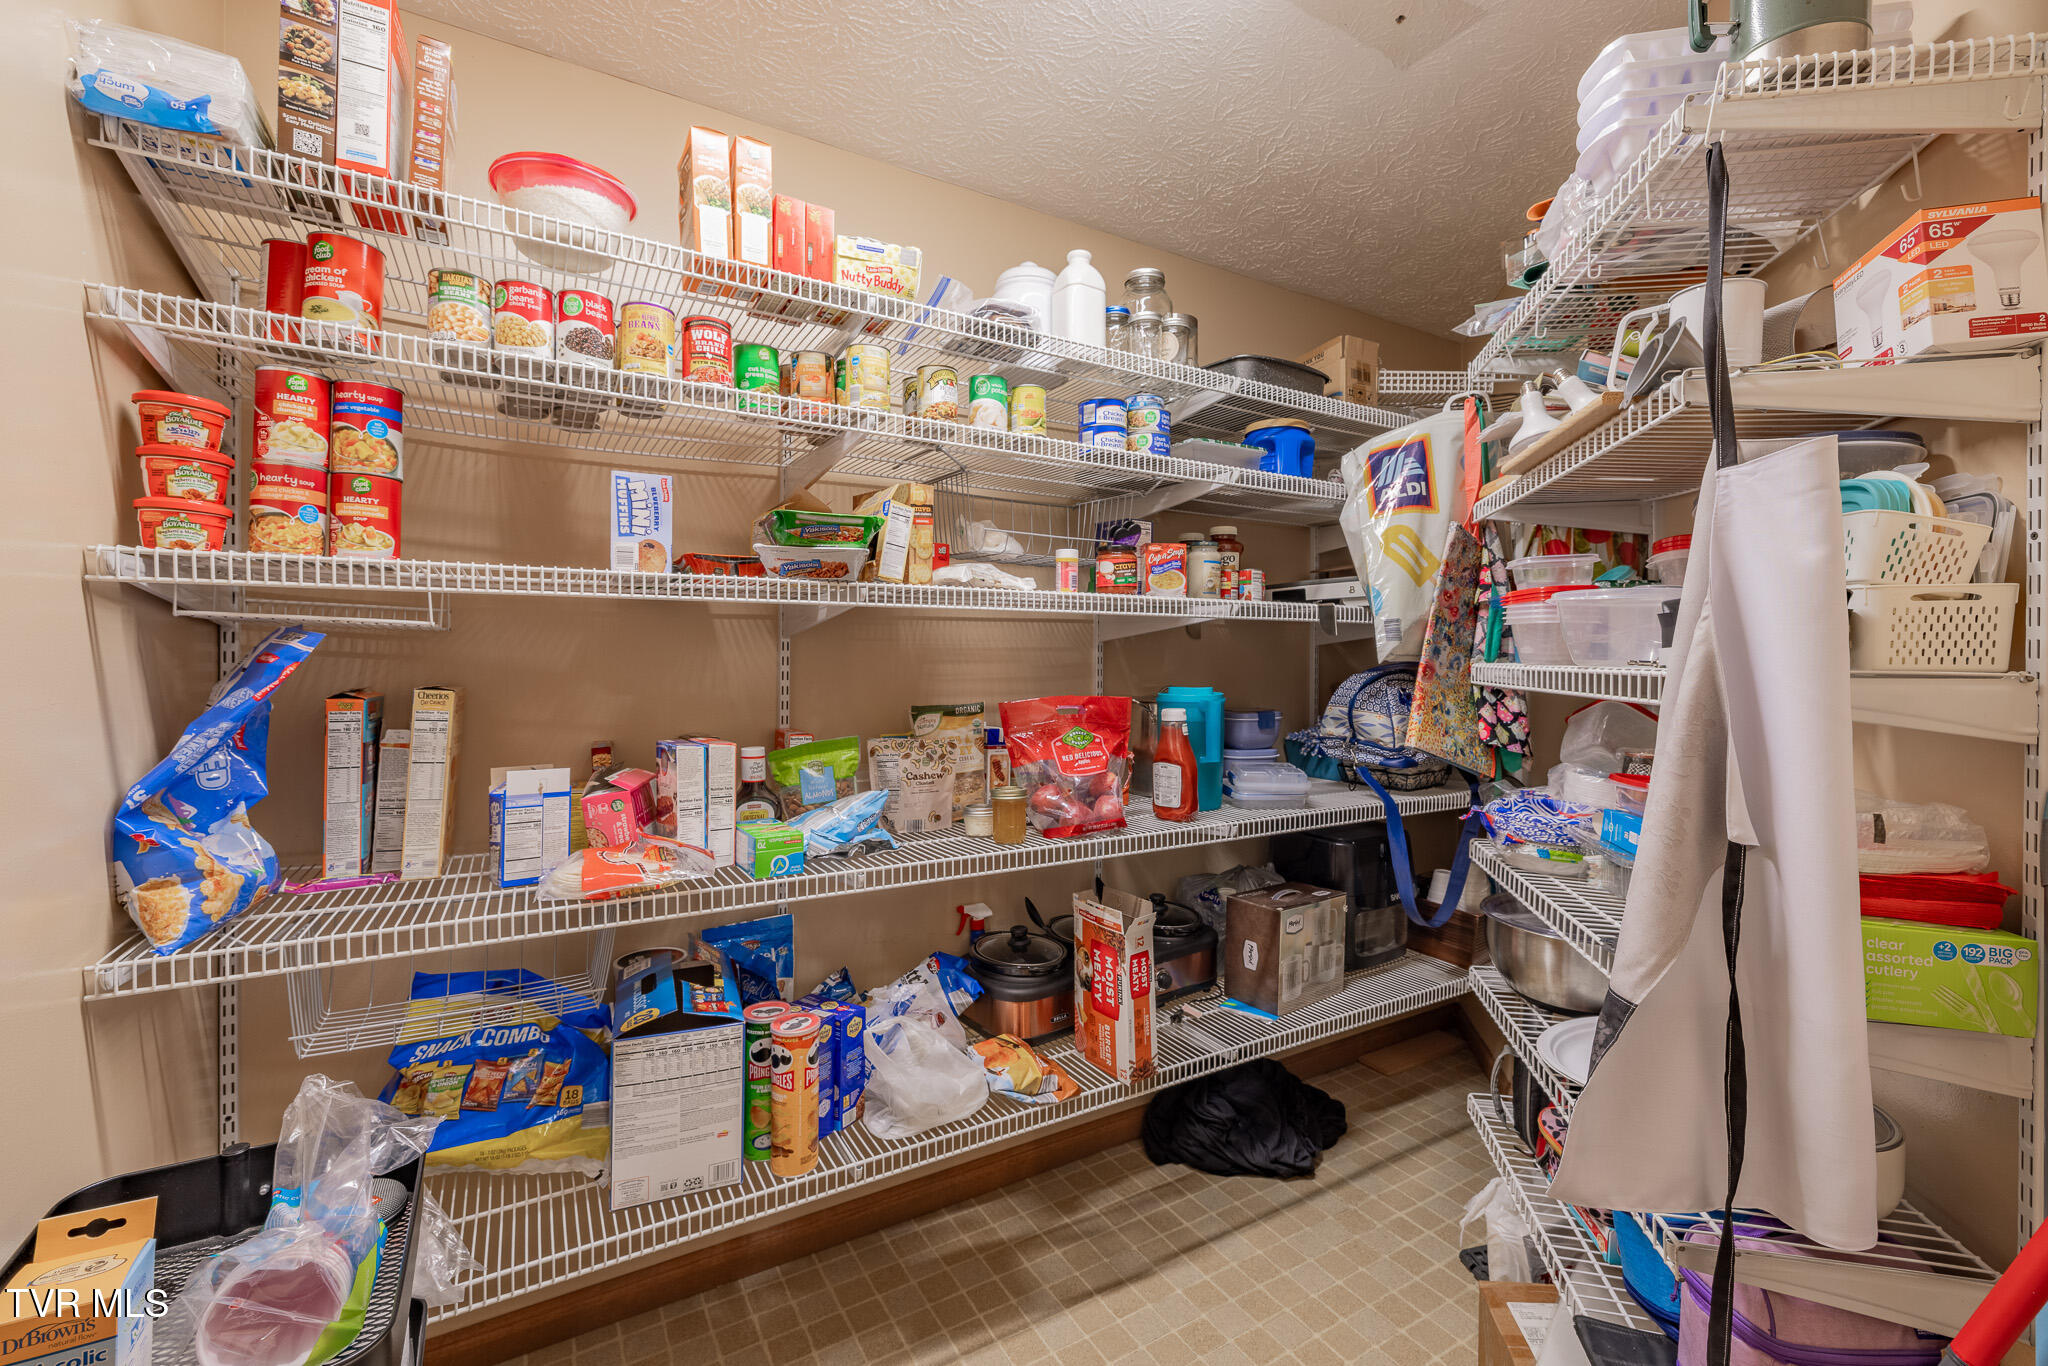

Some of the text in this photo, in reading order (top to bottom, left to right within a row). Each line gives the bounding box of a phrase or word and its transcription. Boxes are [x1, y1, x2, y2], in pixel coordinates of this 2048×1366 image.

[99, 76, 135, 93] Lunch
[1928, 206, 1988, 219] SYLVANIA
[1908, 247, 1920, 260] LED
[305, 266, 347, 276] cream of
[1933, 269, 1943, 278] 2
[305, 273, 343, 284] chicken
[841, 269, 904, 294] Nutty Buddy
[509, 285, 547, 300] garbanzo
[509, 294, 534, 304] beans
[585, 299, 607, 313] black
[585, 308, 608, 321] beans
[628, 320, 661, 331] BEANS
[691, 329, 728, 344] WOLF
[695, 340, 725, 349] BRAND
[696, 346, 725, 355] CHILI
[288, 379, 305, 388] food
[277, 392, 316, 405] HEARTY
[335, 390, 383, 403] hearty soup
[165, 415, 204, 428] BOYARDEE
[175, 469, 212, 480] BOYARDEE
[260, 473, 315, 488] hearty soup
[1381, 484, 1427, 500] ALDI
[343, 496, 379, 505] HEARTY
[616, 478, 629, 534] MUFFINS
[651, 487, 659, 532] BLUEBERRY
[163, 520, 201, 529] BOYARDEE
[784, 562, 819, 571] Yakisoba
[417, 691, 449, 700] Cheerios
[955, 704, 981, 714] ORGANIC
[1062, 750, 1103, 762] RED DELICIOUS
[905, 771, 945, 781] Cashew
[804, 788, 835, 800] ALMONDS
[1866, 937, 1904, 950] clear
[1964, 947, 1983, 957] 192
[1989, 947, 2013, 958] BIG
[1866, 952, 1933, 967] assorted
[1989, 957, 2013, 965] PACK
[1093, 948, 1102, 1003] MEATY
[1132, 958, 1140, 992] MEATY
[1866, 965, 1918, 981] cutlery
[1105, 955, 1115, 1008] MOIST
[1053, 1014, 1068, 1022] BELLA
[409, 1025, 550, 1062] SNACK COMBO
[1104, 1024, 1112, 1067] BURGER
[749, 1063, 770, 1080] PRING
[565, 1090, 579, 1100] 18
[48, 1337, 77, 1349] natural
